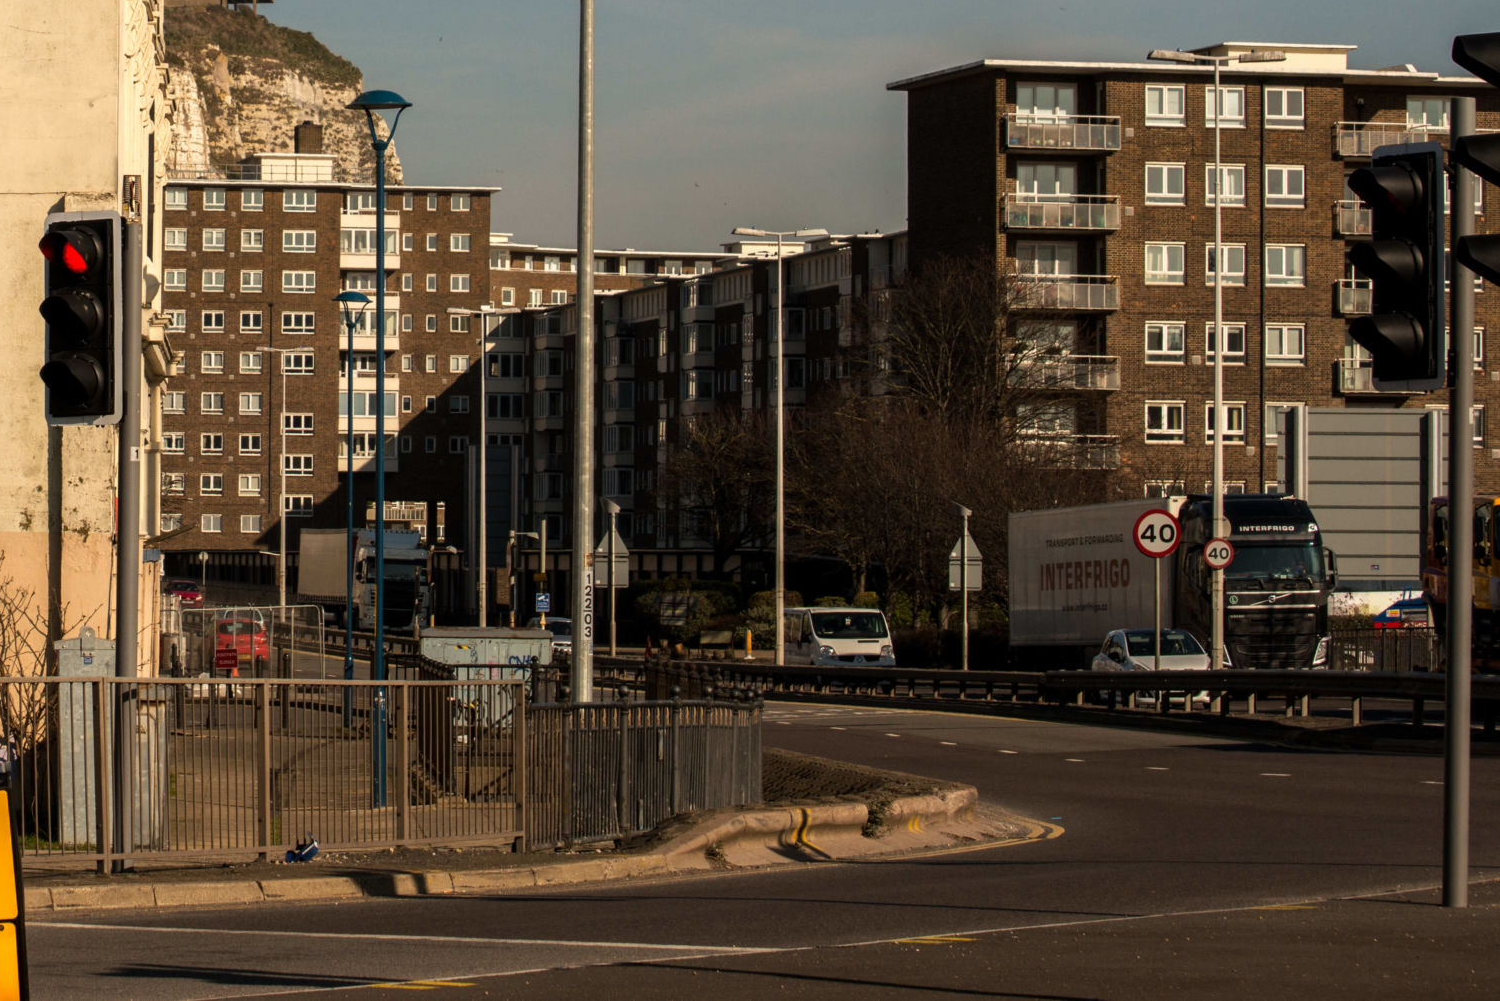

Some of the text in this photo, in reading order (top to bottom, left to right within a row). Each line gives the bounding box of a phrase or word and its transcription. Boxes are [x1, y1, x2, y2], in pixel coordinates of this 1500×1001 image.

[1046, 537, 1079, 549] TRANSPORT
[1085, 533, 1124, 545] FORWARDING
[1140, 524, 1175, 543] 40
[1208, 547, 1229, 559] 40
[1040, 558, 1130, 591] INTERFRIGO
